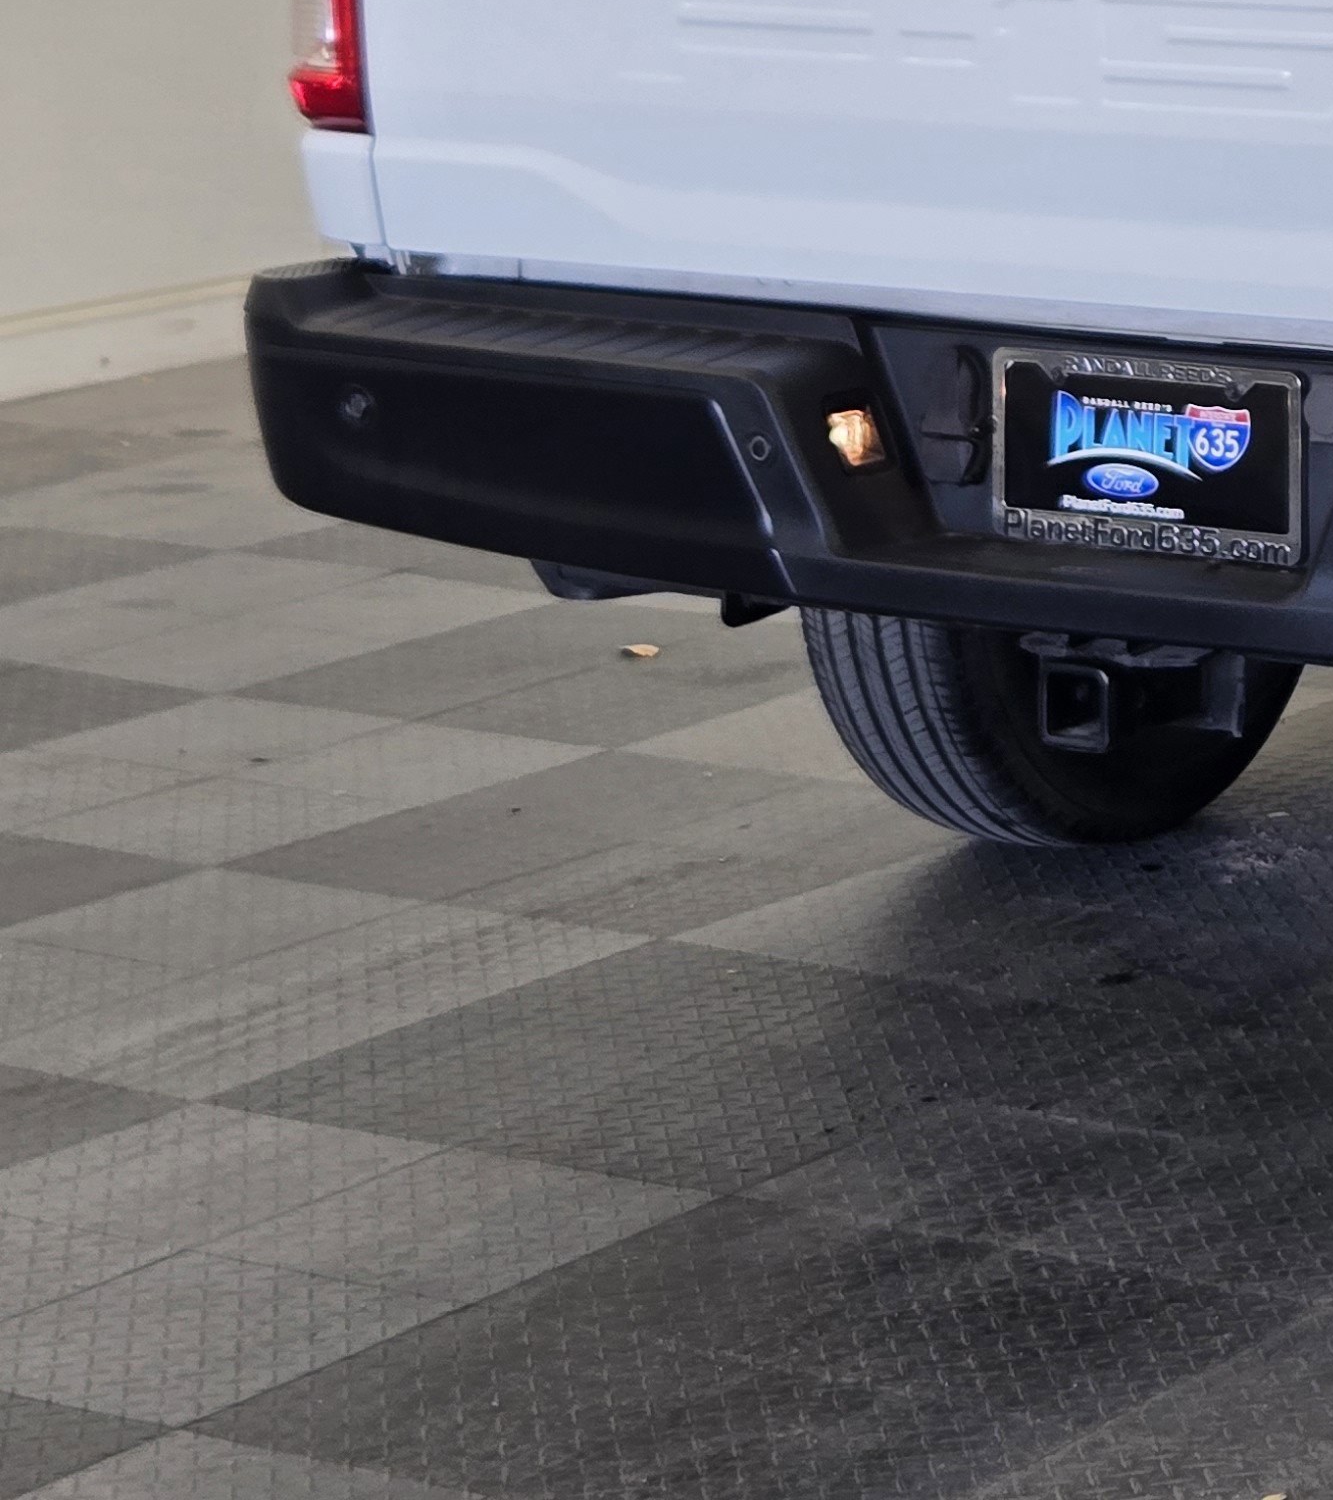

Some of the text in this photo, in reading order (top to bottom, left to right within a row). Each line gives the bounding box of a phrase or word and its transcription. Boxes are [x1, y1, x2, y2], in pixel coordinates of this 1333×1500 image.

[1065, 354, 1156, 377] RANDALL
[1055, 390, 1194, 468] PLANET
[1196, 428, 1241, 460] 635
[1101, 468, 1143, 493] Ford
[1003, 508, 1291, 565] PlanetFord635.com
